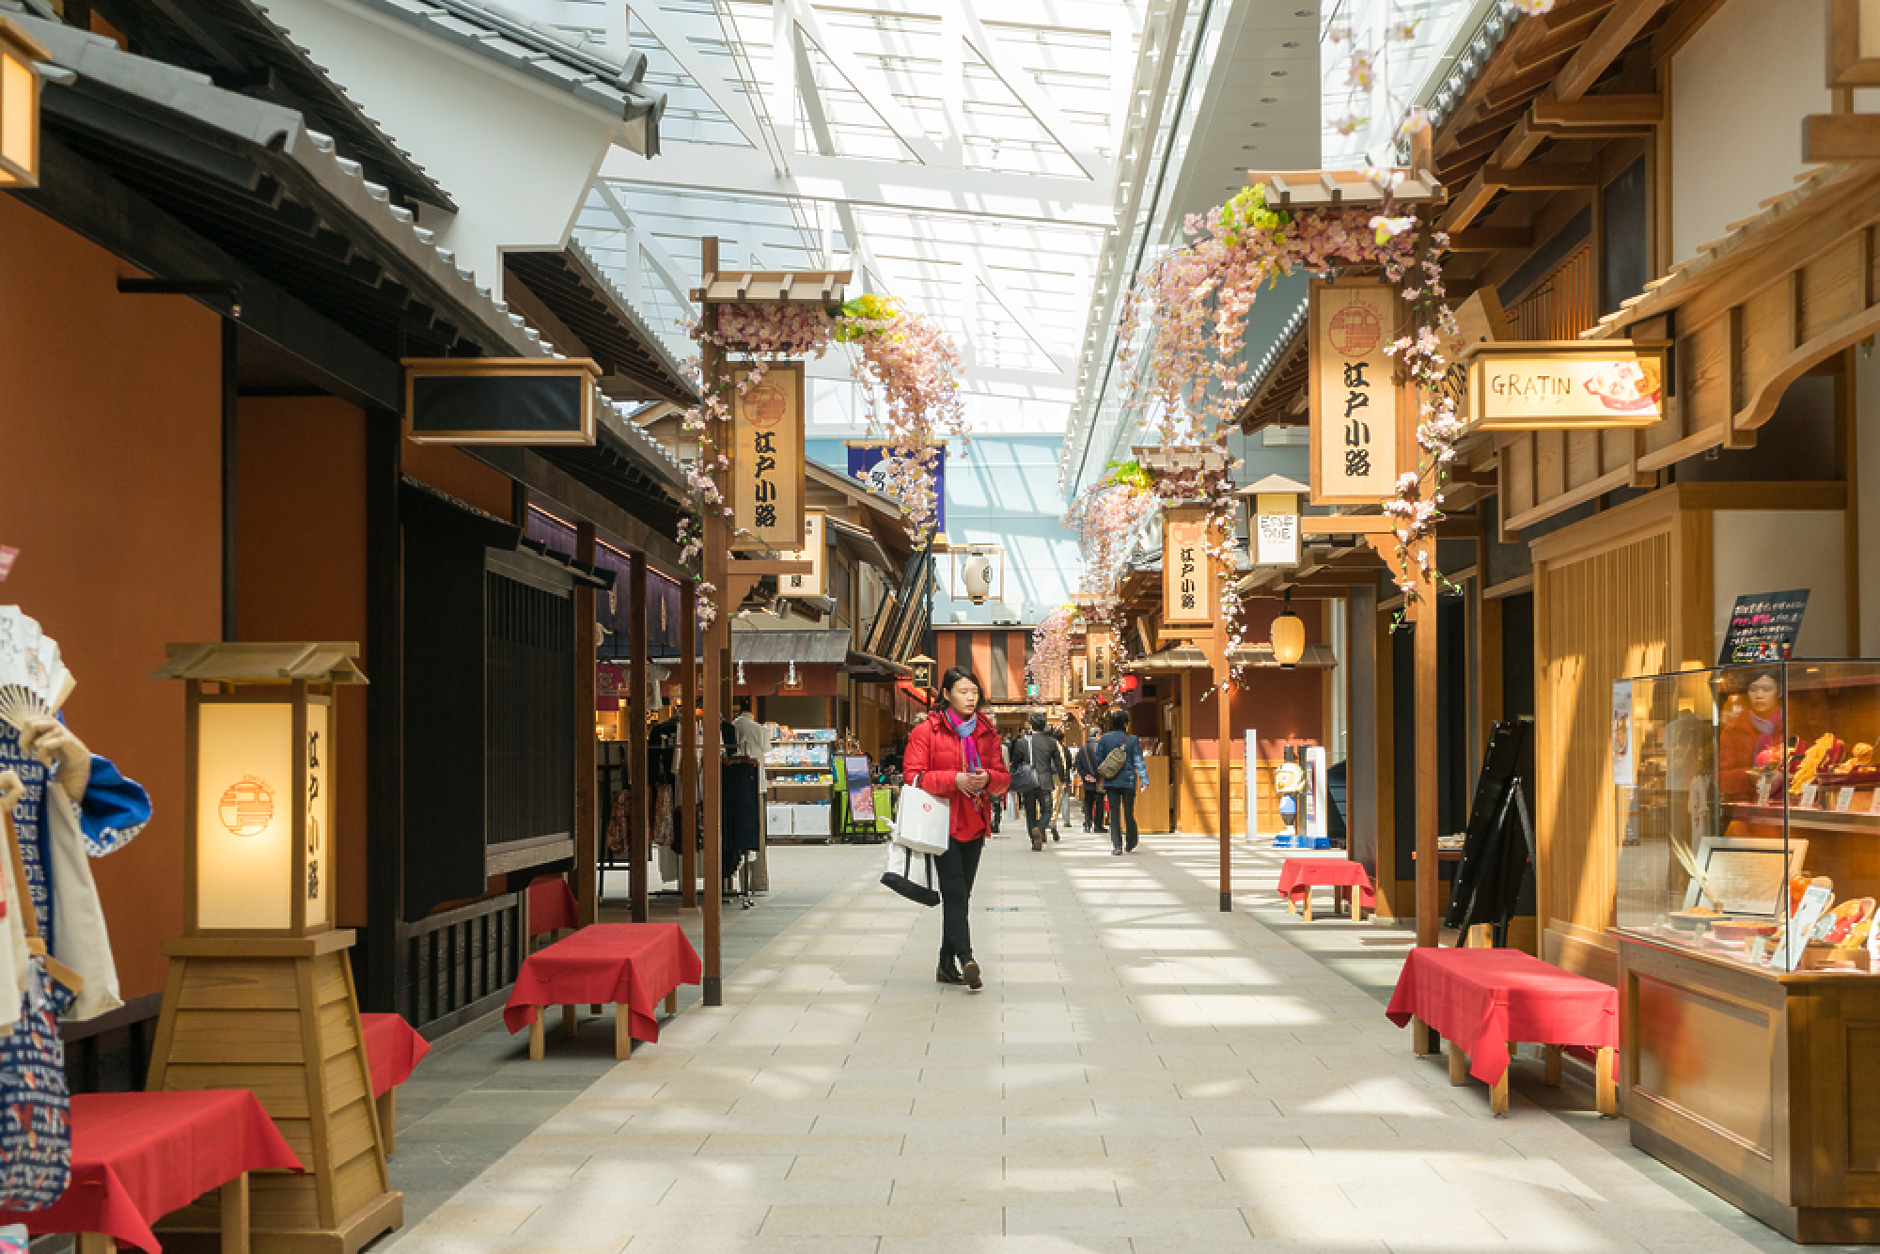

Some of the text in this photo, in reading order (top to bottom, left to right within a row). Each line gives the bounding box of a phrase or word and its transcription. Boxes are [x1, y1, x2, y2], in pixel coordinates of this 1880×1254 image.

[1344, 361, 1371, 477] 江戸小路
[1491, 374, 1571, 395] GRATIN
[754, 431, 777, 527] 江戸小路
[1180, 546, 1196, 610] 江戸小路
